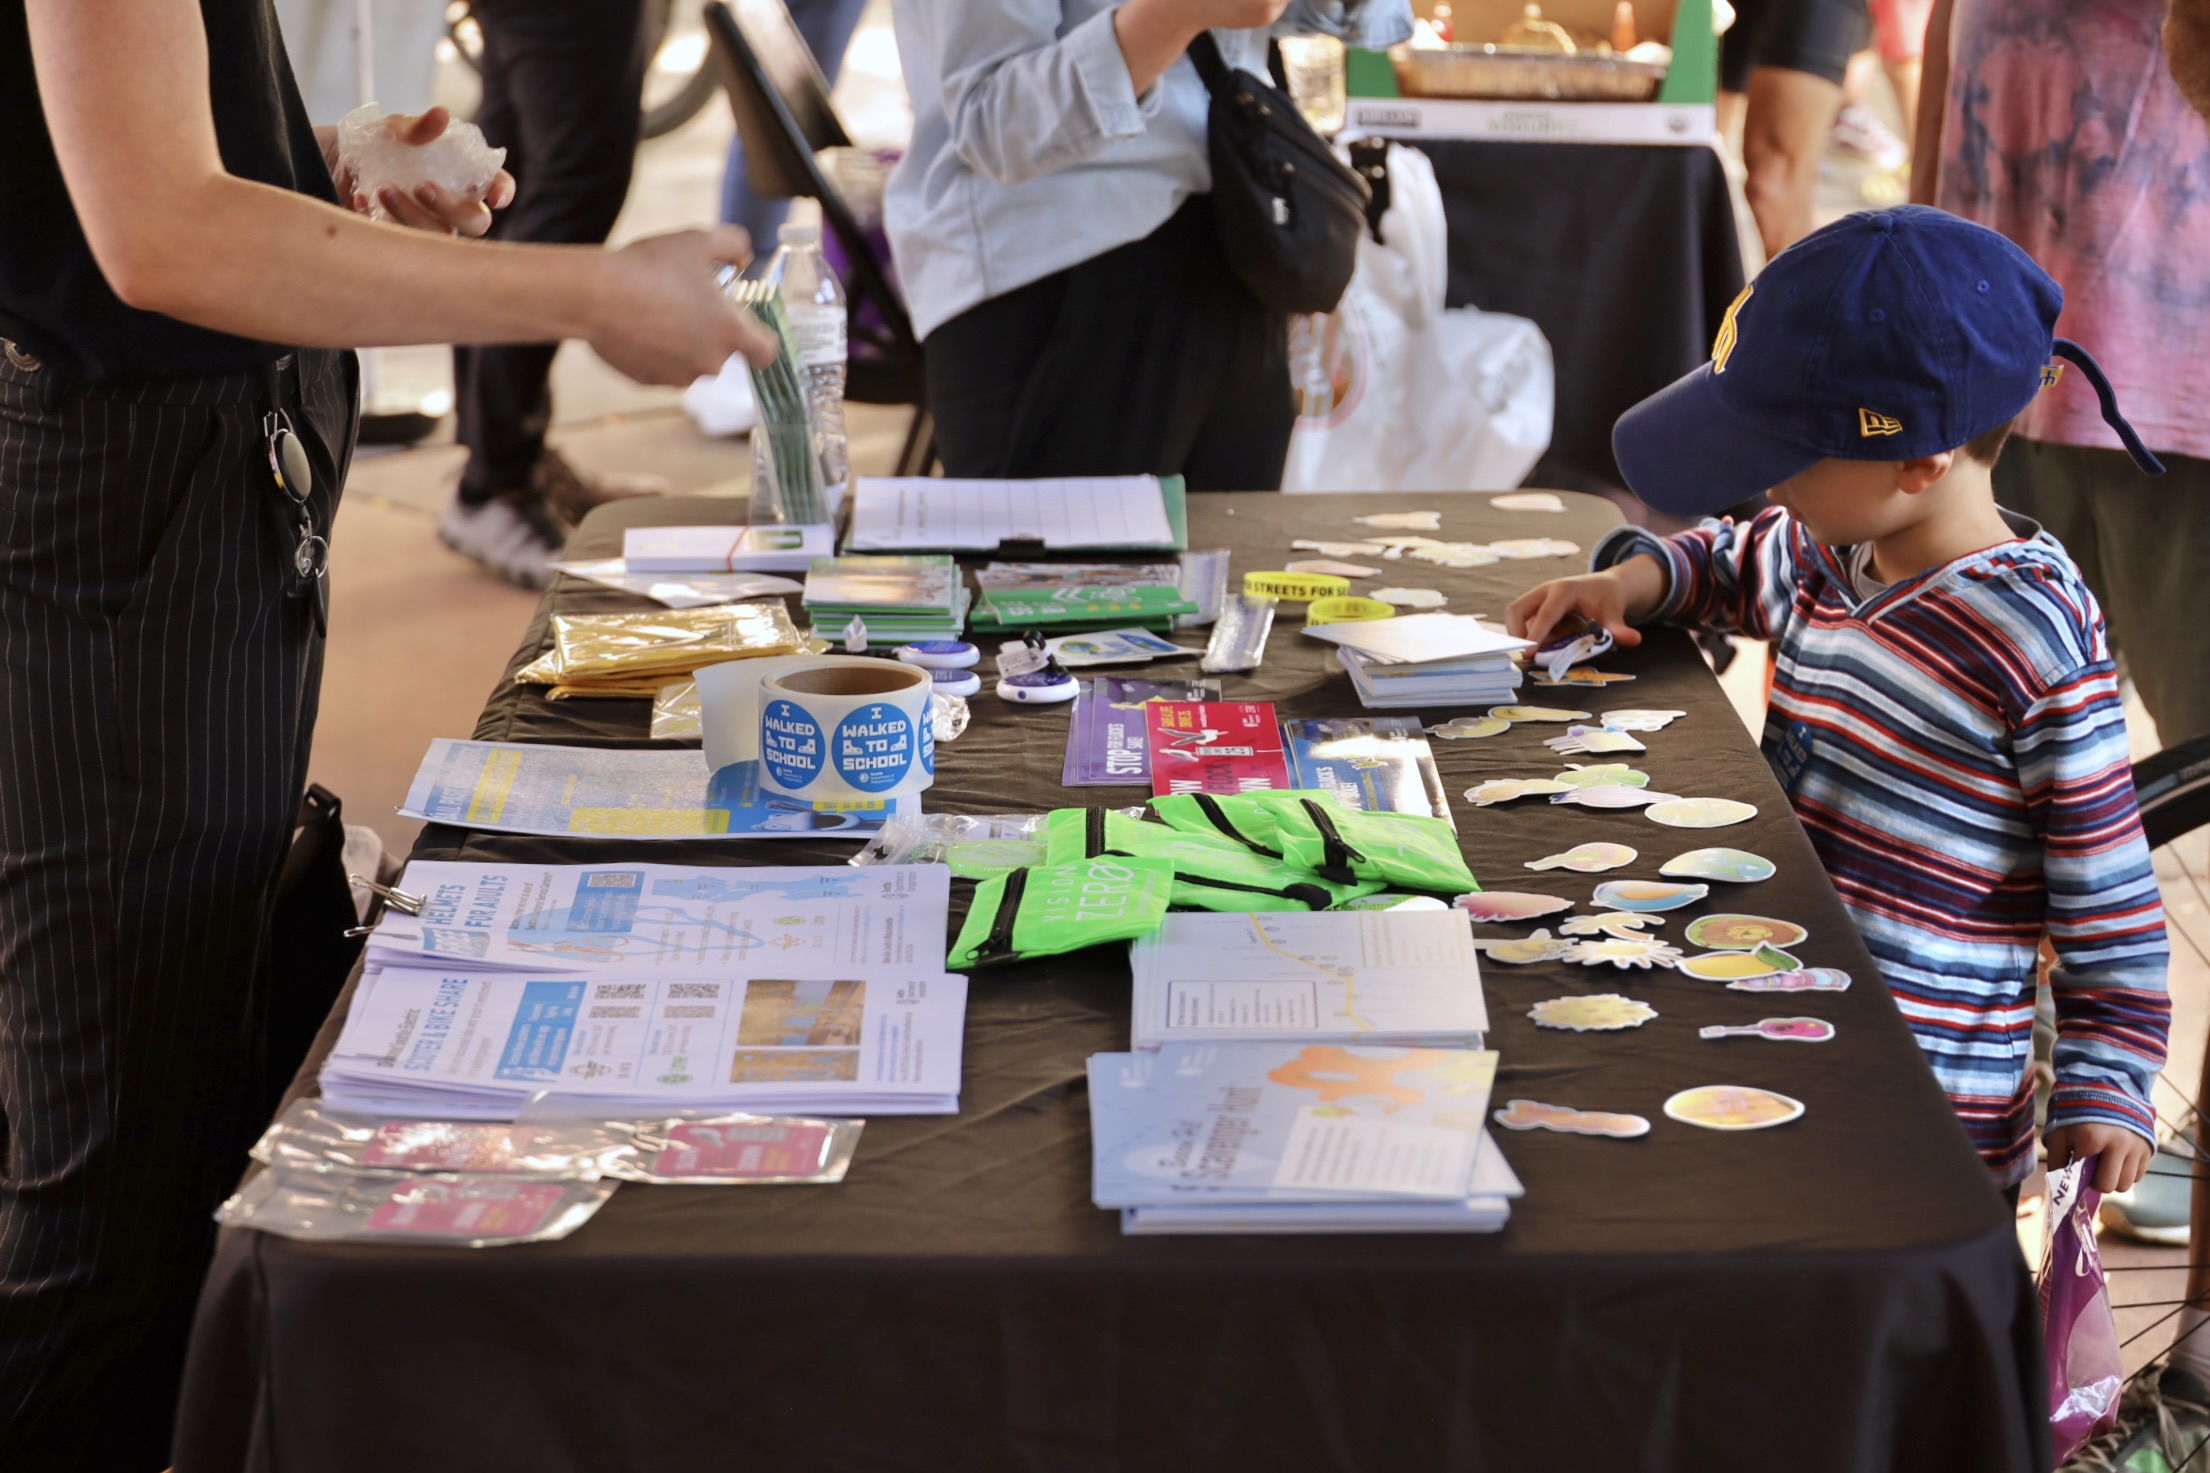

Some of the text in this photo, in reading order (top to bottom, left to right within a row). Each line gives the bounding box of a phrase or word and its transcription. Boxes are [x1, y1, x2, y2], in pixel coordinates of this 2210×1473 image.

[1254, 582, 1307, 597] STREETS
[1311, 585, 1334, 597] FOR
[780, 704, 790, 717] I
[871, 707, 882, 719] I
[765, 716, 816, 736] WALKED
[842, 720, 907, 737] WALKED
[778, 735, 796, 750] TO
[865, 739, 888, 753] TO
[766, 749, 817, 770] SCHOOL
[843, 753, 907, 771] SCHOOL
[1106, 750, 1142, 775] STOP
[1207, 764, 1234, 790] FLOCK
[1170, 779, 1203, 796] OW
[465, 874, 508, 928] FOR ADULTS
[1042, 865, 1078, 922] VISION
[425, 884, 466, 926] HELMETS
[433, 977, 468, 1009] SHARE
[1207, 1086, 1264, 1113] Hunt
[1180, 1115, 1261, 1180] Scavenger
